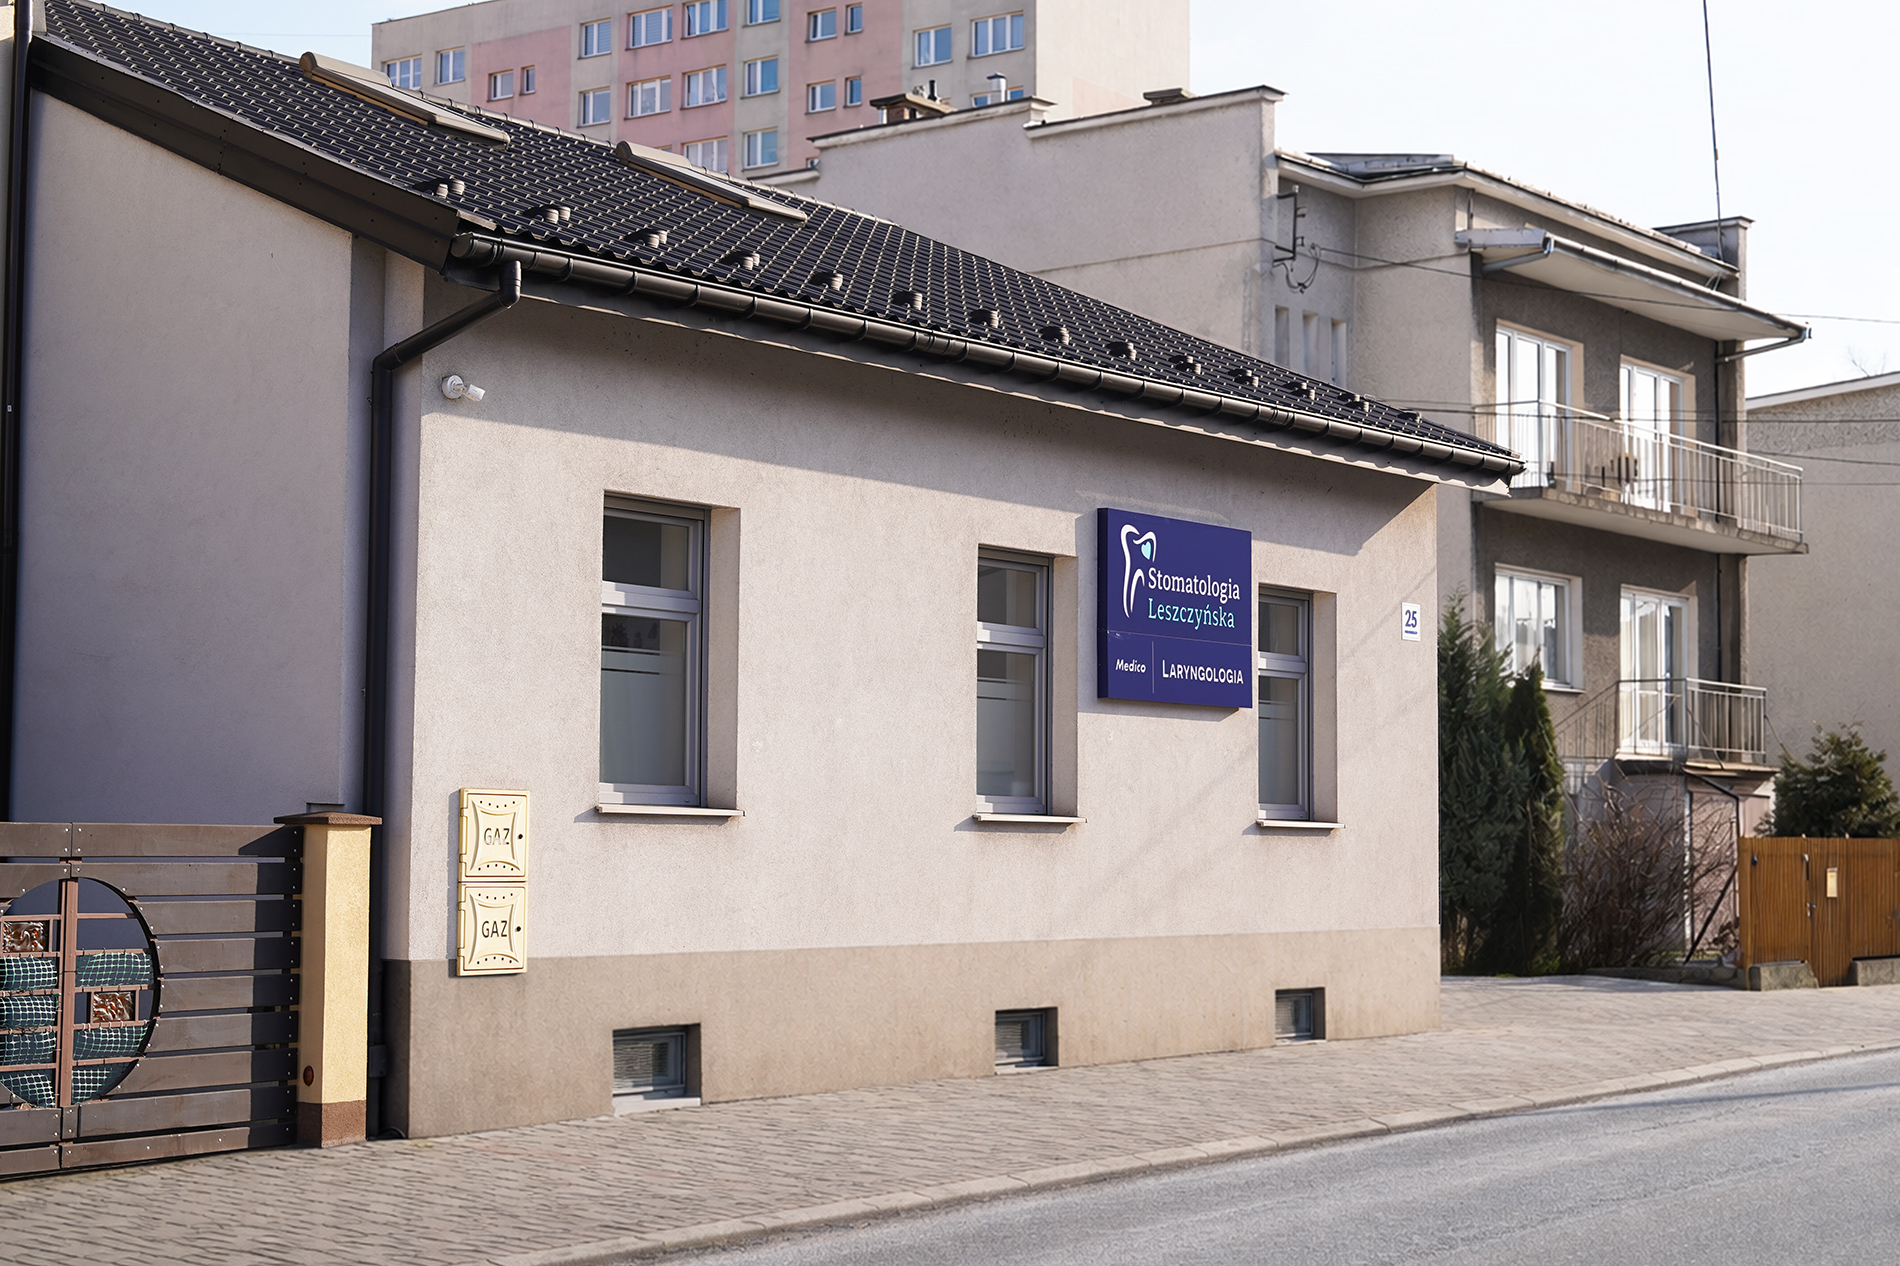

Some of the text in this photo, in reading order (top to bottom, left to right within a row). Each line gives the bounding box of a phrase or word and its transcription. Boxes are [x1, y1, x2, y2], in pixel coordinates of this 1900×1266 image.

[1148, 567, 1240, 604] Stomatologia
[1148, 598, 1235, 630] Leszczyńska
[1405, 609, 1417, 628] 25
[1115, 659, 1147, 673] Medico
[1162, 660, 1244, 684] LARYNGOLOGIA
[484, 827, 510, 845] GAZ
[481, 920, 508, 938] GAZ
